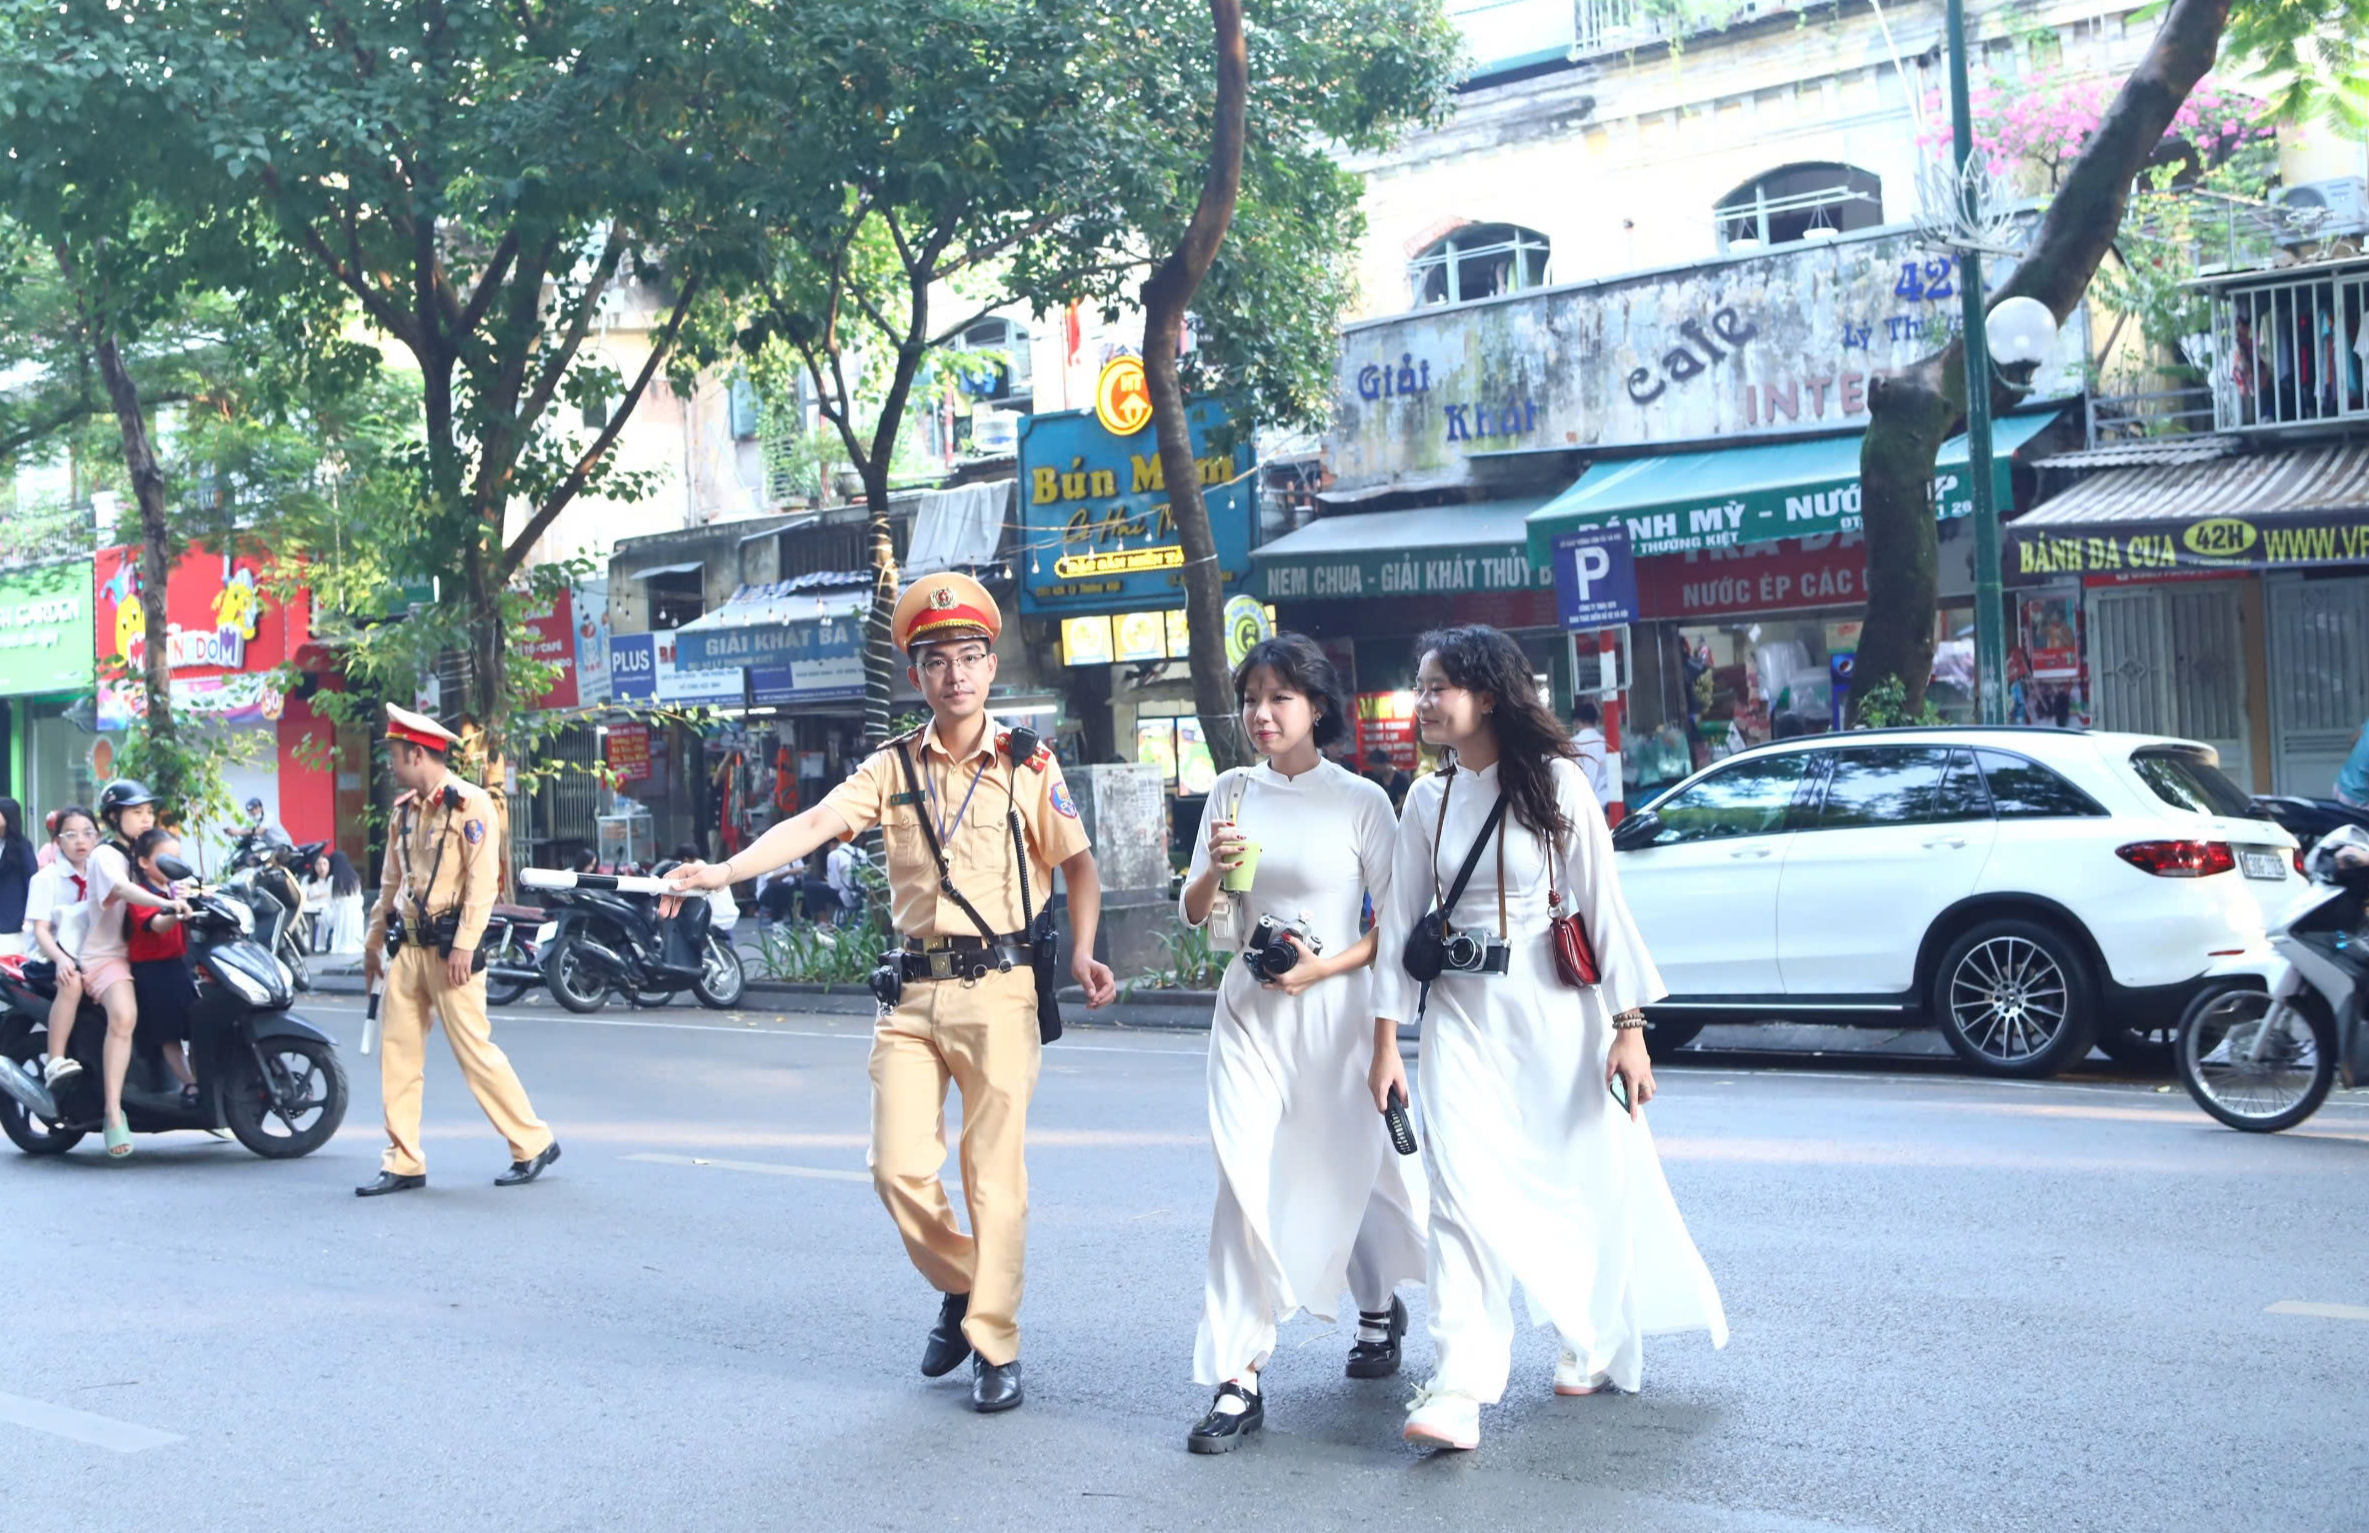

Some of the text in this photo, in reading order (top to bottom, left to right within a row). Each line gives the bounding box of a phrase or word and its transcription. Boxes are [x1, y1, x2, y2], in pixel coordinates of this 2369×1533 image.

[1843, 320, 1872, 351] Lý
[1746, 367, 1880, 425] INTE
[1032, 453, 1234, 504] Bún Mm
[1785, 484, 1862, 522] NƯỚ
[1705, 530, 1739, 548] KIỆT
[2127, 534, 2176, 567] CUA
[2196, 523, 2244, 550] 42H
[1267, 566, 1307, 596] NEM
[1313, 564, 1362, 594] CHUA
[1381, 552, 1419, 592] GIẢI
[1426, 553, 1476, 590] KHÁT
[1575, 546, 1610, 601] P
[1682, 576, 1751, 608] NƯỚC
[1759, 575, 1791, 601] ÉP
[1801, 567, 1852, 597] CÁC
[166, 626, 237, 664] INGDOM
[612, 650, 650, 672] PLUS
